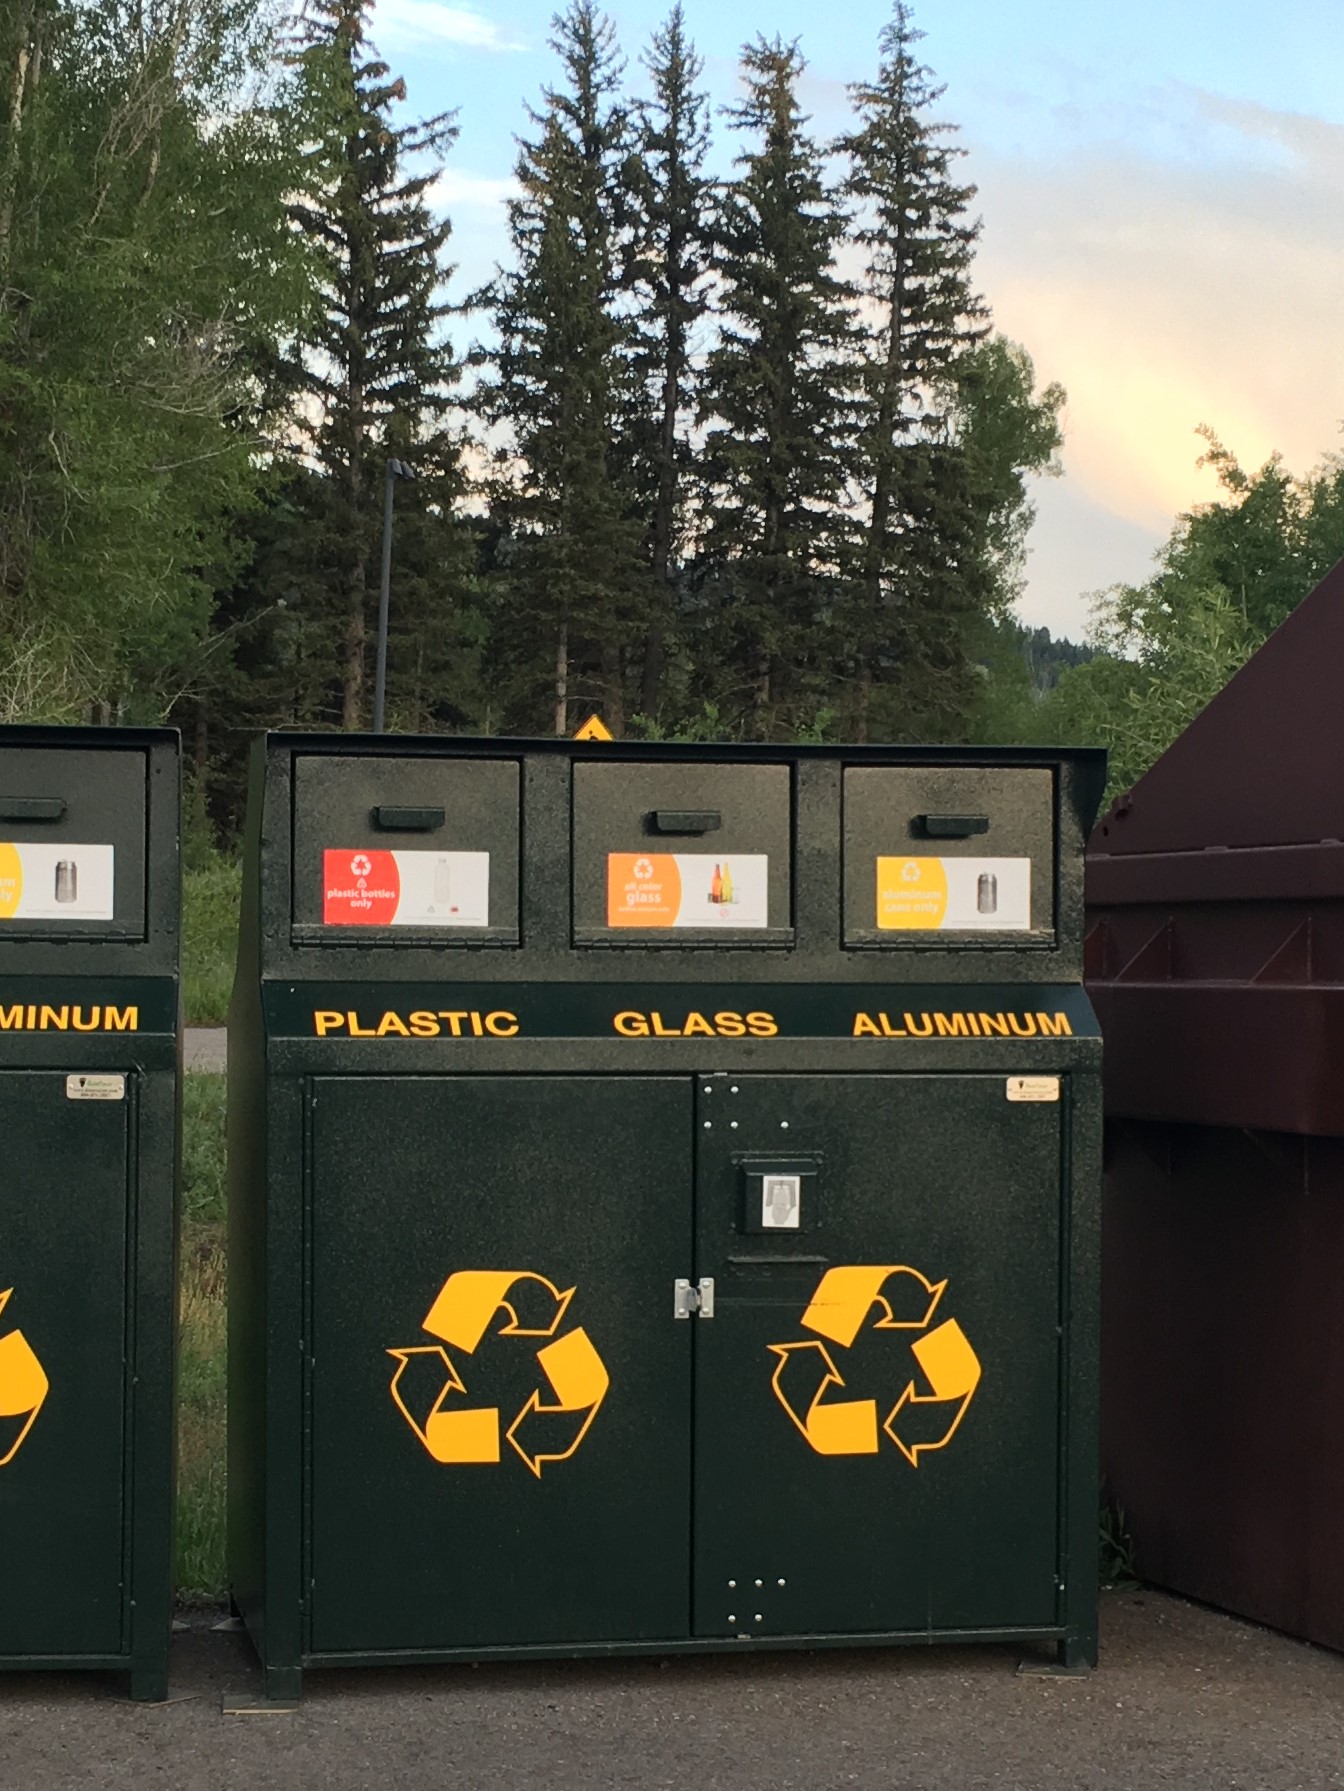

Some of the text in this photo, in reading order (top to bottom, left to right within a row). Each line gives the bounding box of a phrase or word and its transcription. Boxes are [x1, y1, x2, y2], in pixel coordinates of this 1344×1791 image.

[327, 888, 396, 900] plastic bottles
[626, 890, 662, 906] glass
[350, 898, 373, 910] only
[913, 900, 940, 915] only
[313, 1010, 520, 1037] PLASTIC
[613, 1011, 779, 1037] GLASS
[852, 1011, 1073, 1038] ALUMINUM
